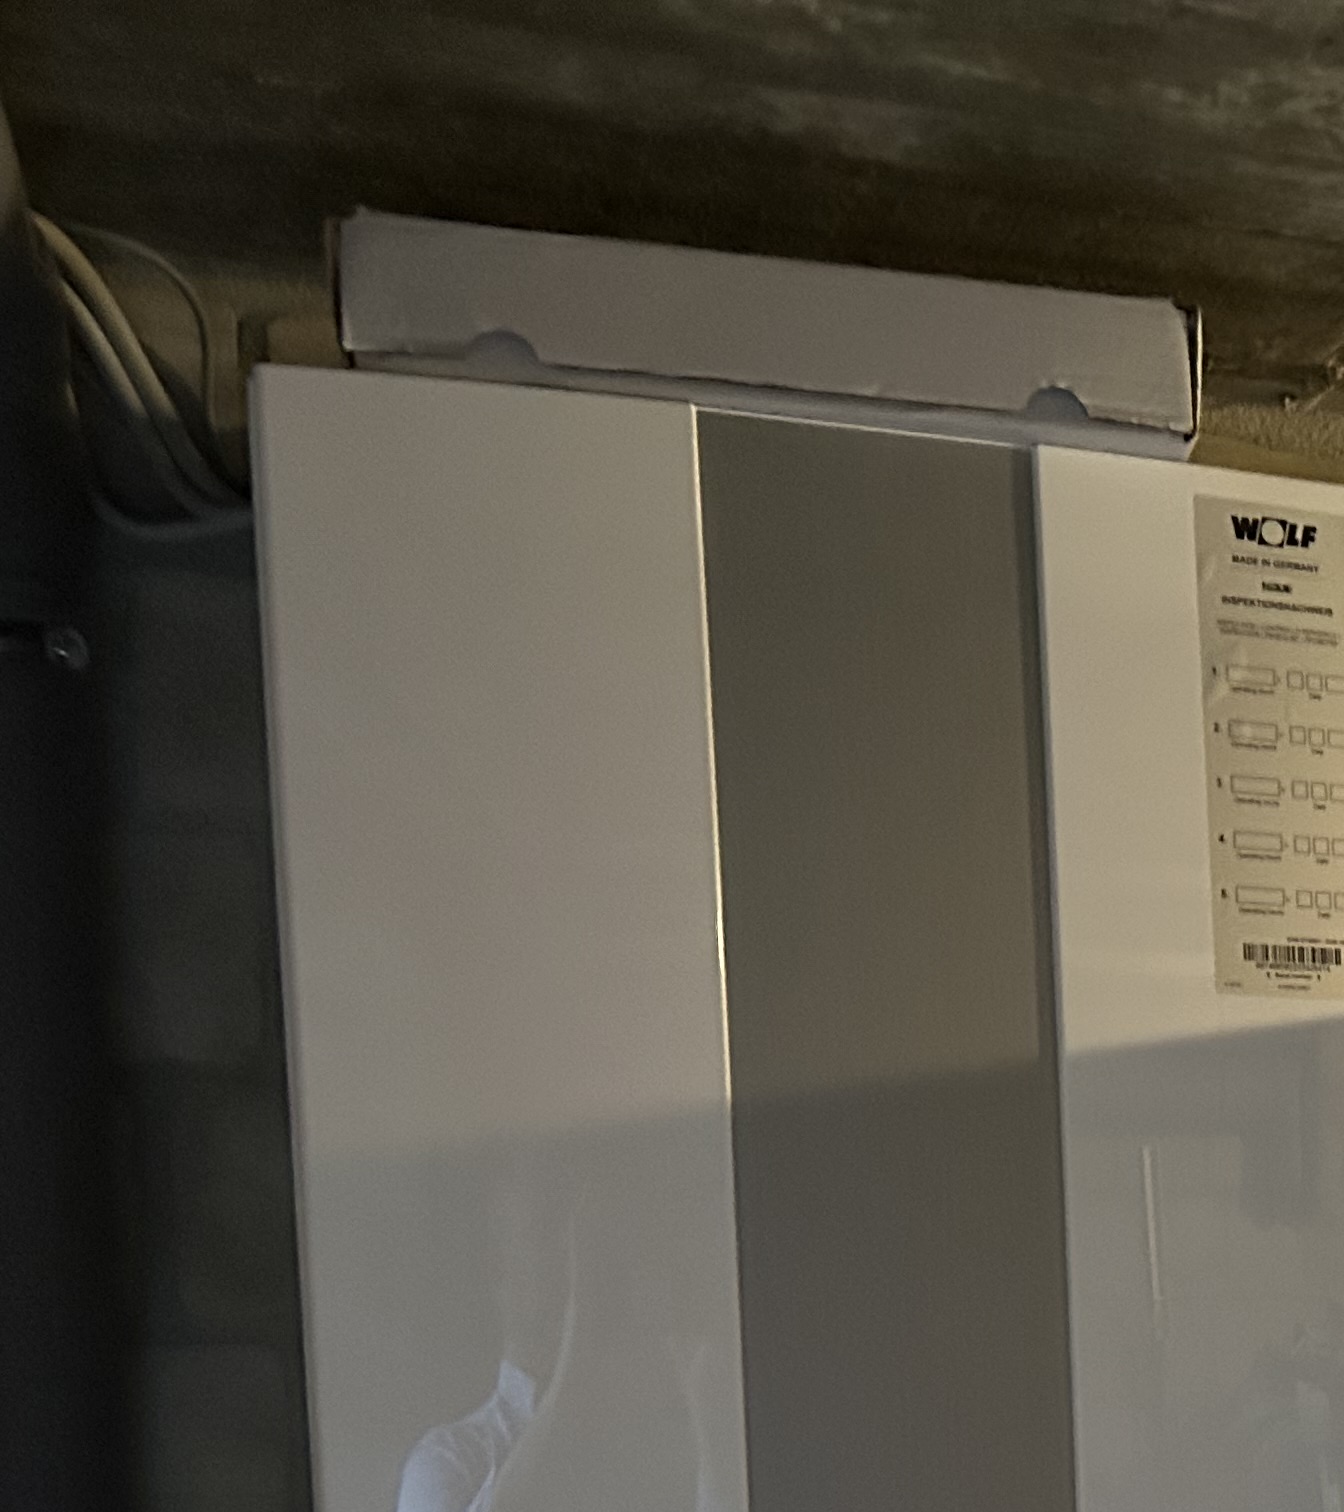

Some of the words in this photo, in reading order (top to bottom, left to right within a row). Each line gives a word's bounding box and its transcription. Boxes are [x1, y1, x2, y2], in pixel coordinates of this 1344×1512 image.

[1231, 515, 1317, 548] WOLF
[1231, 554, 1258, 566] MADE
[1261, 557, 1271, 567] IN
[1273, 560, 1319, 573] GERMANY
